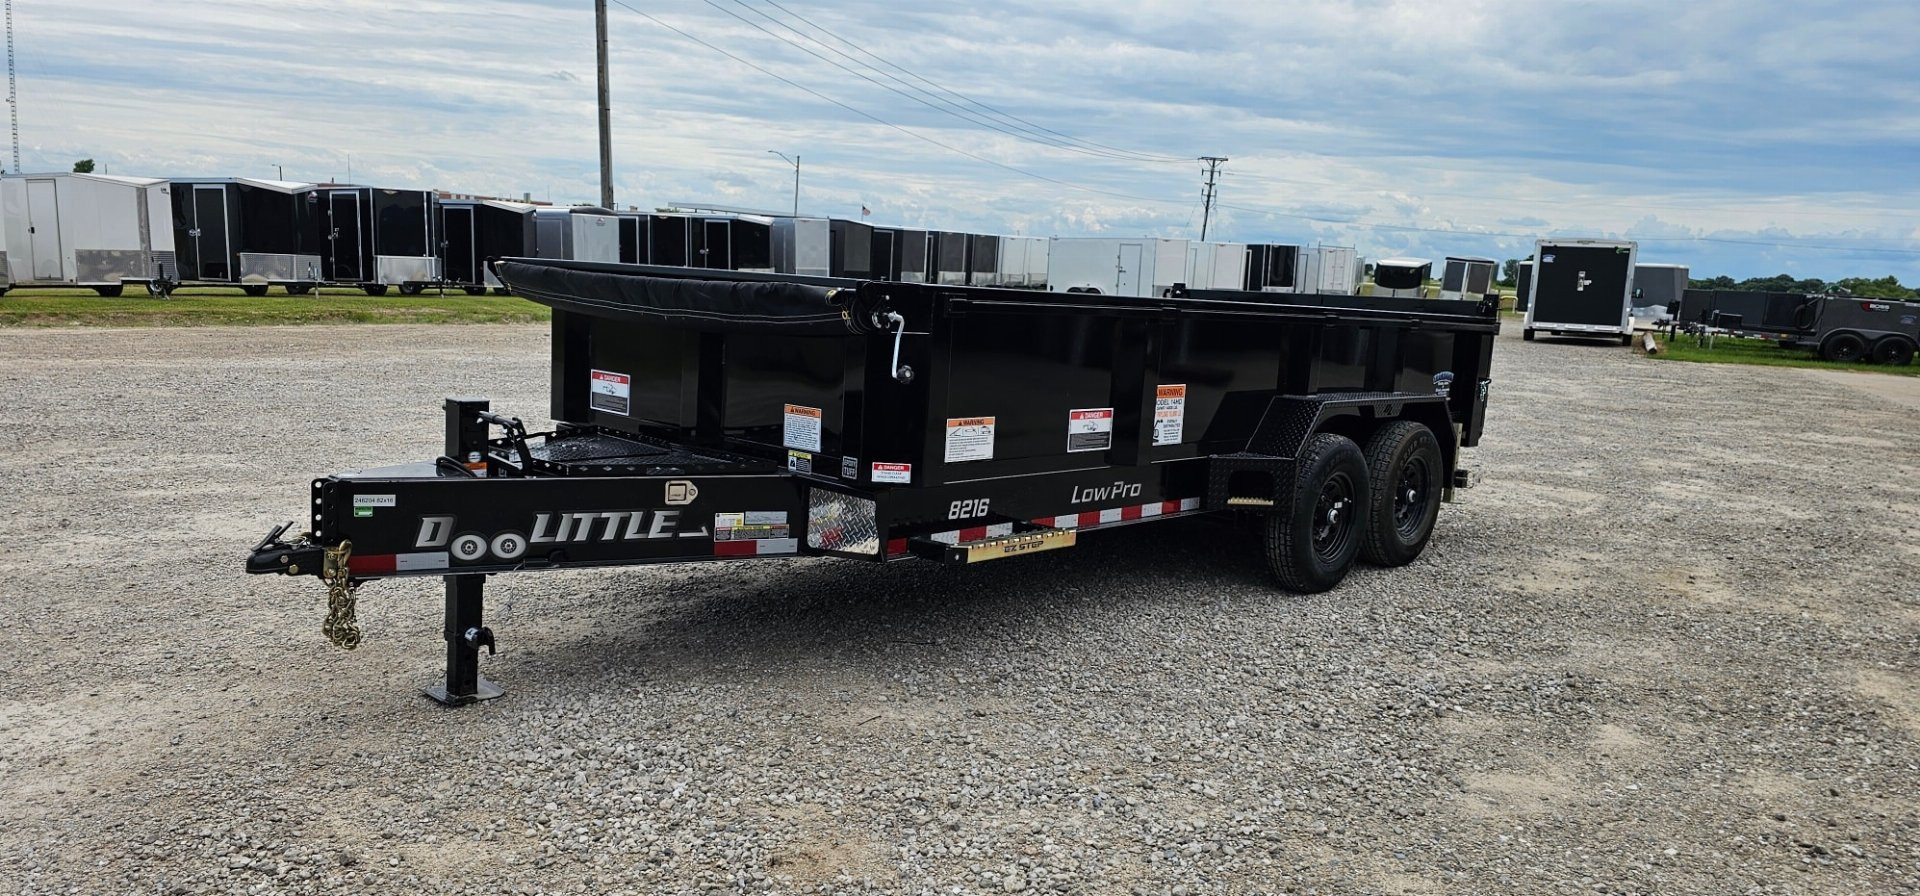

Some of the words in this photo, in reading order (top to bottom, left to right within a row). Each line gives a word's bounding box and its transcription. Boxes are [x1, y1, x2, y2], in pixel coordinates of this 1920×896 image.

[1158, 388, 1183, 396] WARNING
[795, 407, 816, 416] WARNING
[948, 498, 990, 520] 8216
[1019, 540, 1044, 550] STEP
